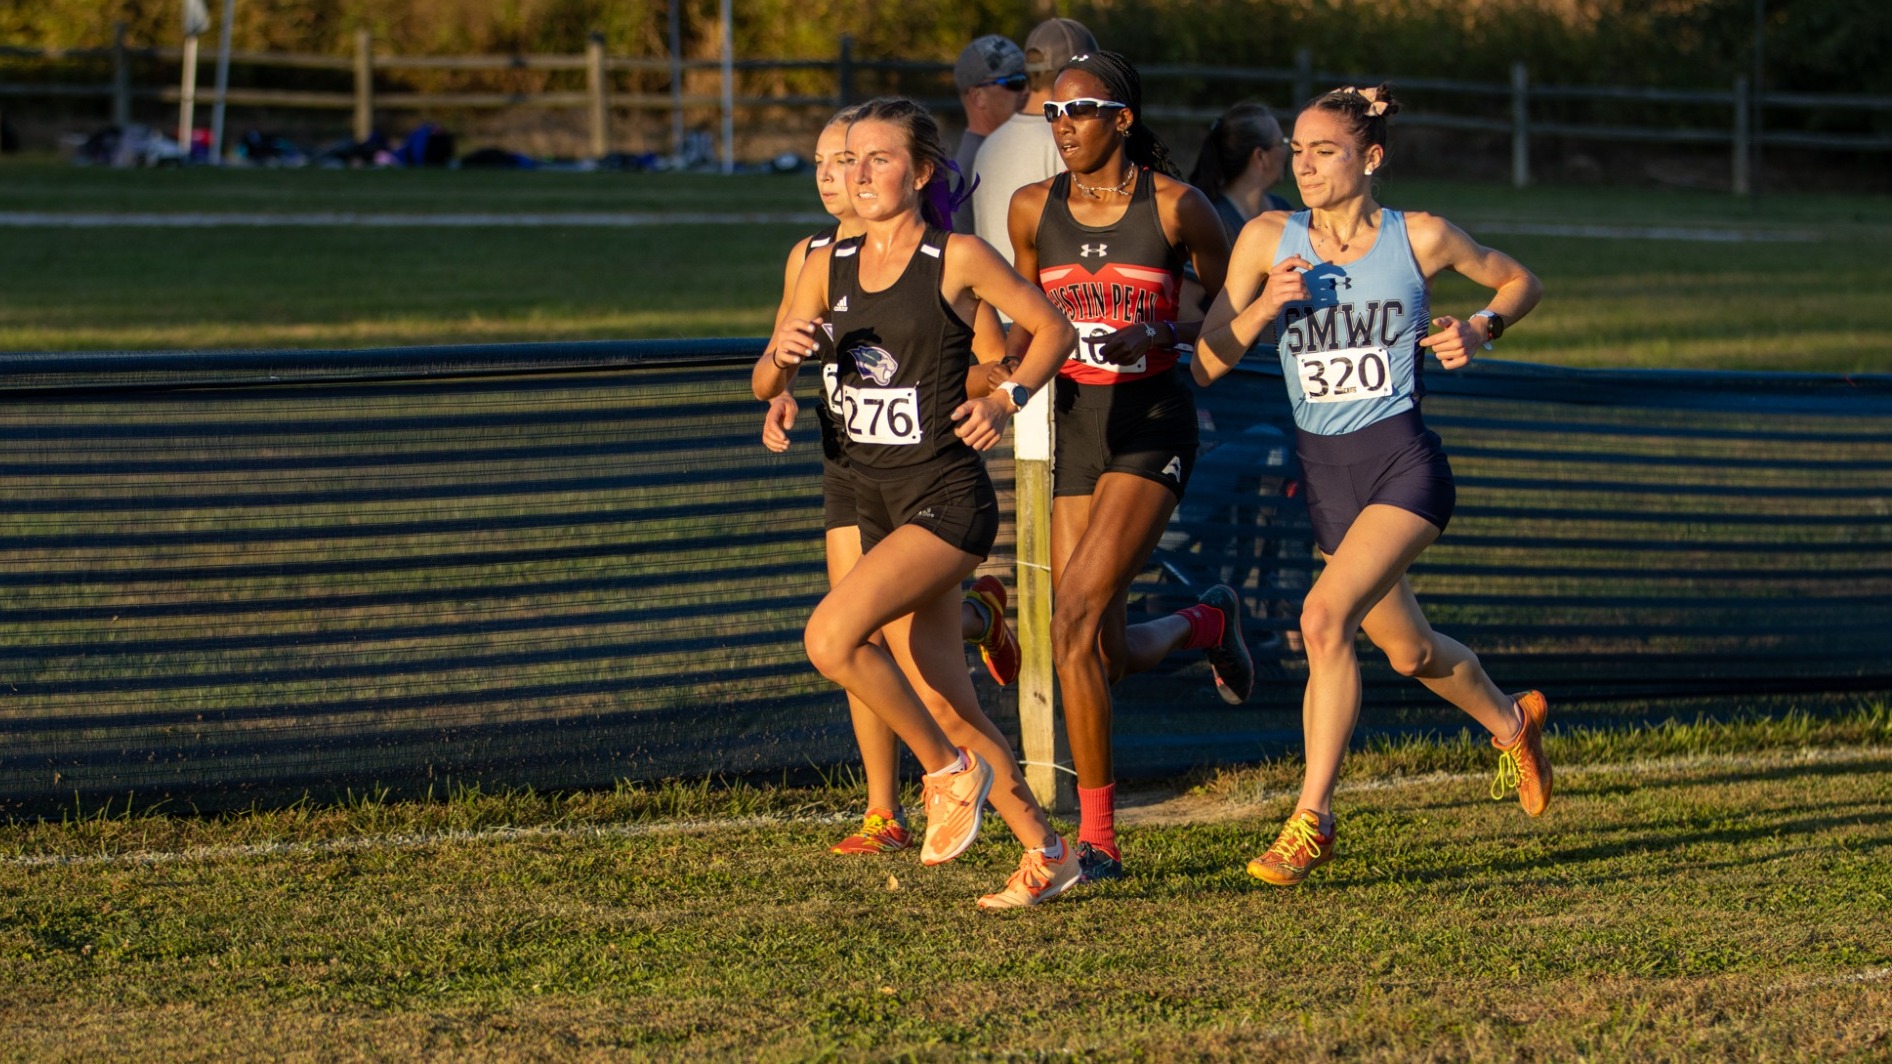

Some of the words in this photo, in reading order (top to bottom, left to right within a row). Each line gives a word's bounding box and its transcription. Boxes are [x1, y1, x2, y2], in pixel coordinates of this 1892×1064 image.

[1046, 282, 1107, 321] USTIN
[1111, 283, 1160, 324] PEAY
[1286, 299, 1404, 355] SMWC
[1304, 353, 1386, 397] 320
[845, 396, 914, 437] 276
